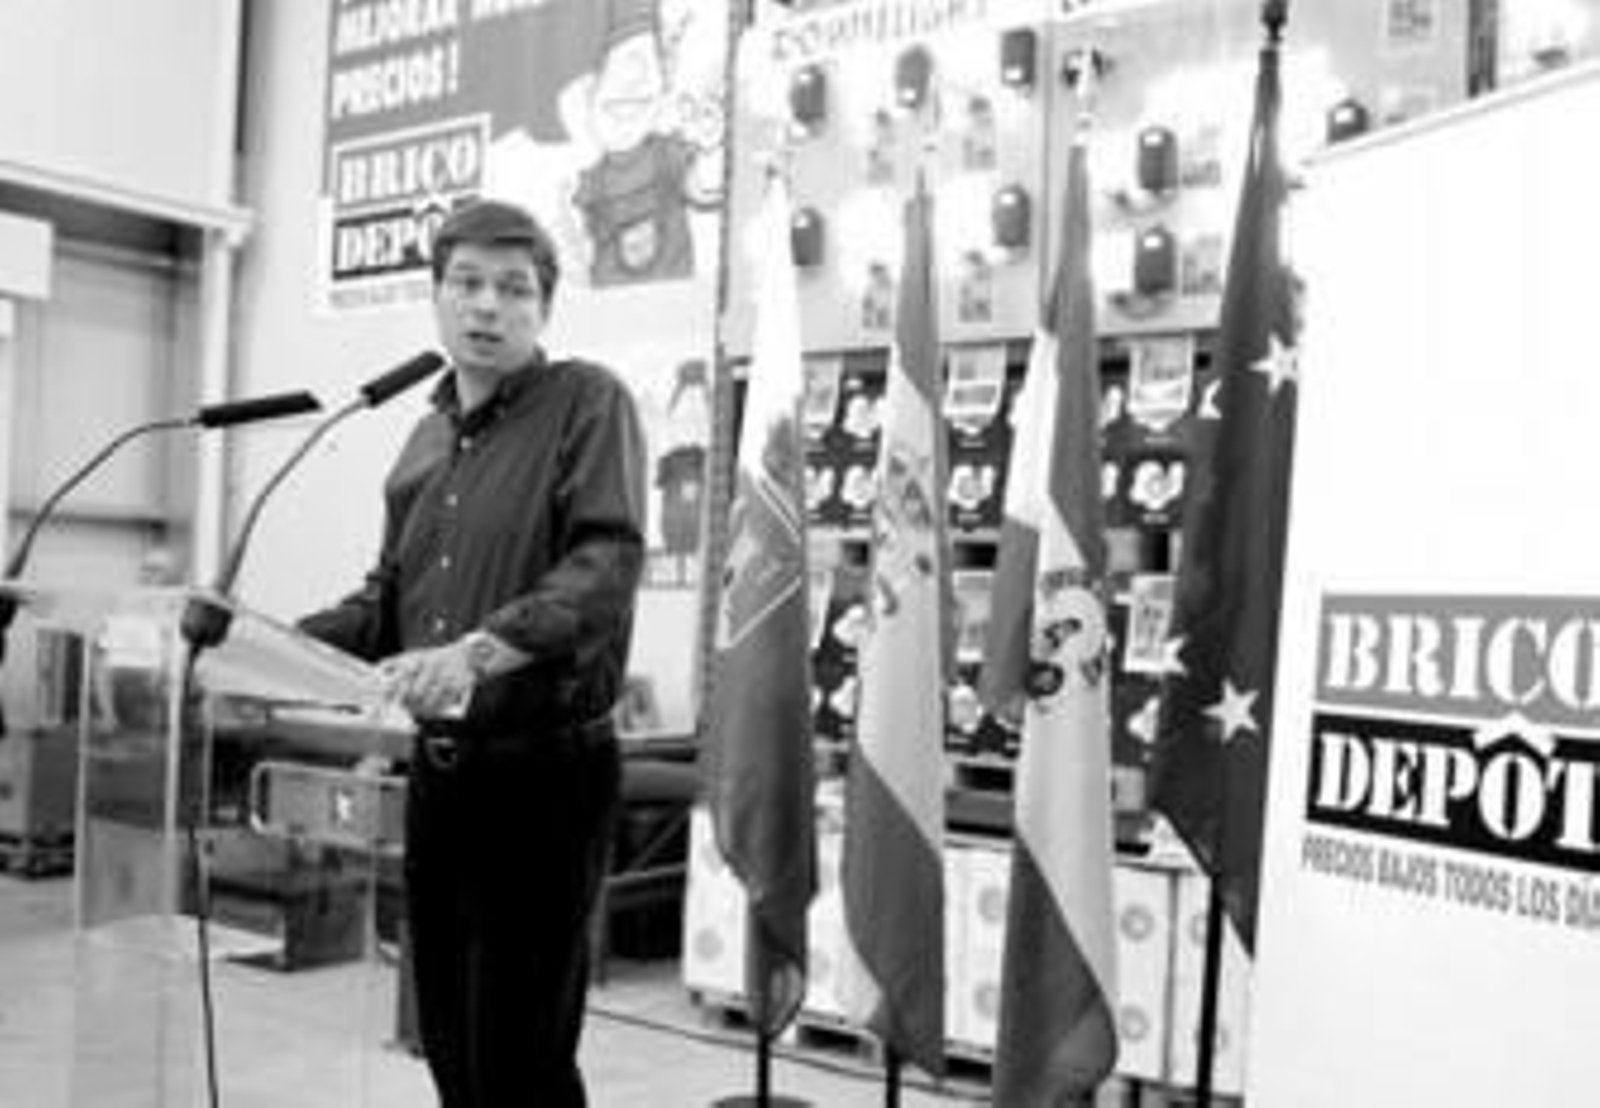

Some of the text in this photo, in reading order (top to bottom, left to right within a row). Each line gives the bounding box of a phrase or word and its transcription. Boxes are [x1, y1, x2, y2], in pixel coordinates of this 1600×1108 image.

[340, 134, 478, 204] BRICO
[1325, 611, 1600, 711] BRICO
[1301, 834, 1375, 882] PRECIOS
[1378, 846, 1438, 897] BAJOS
[1443, 857, 1513, 914] TODOS
[1516, 873, 1561, 924] LOS
